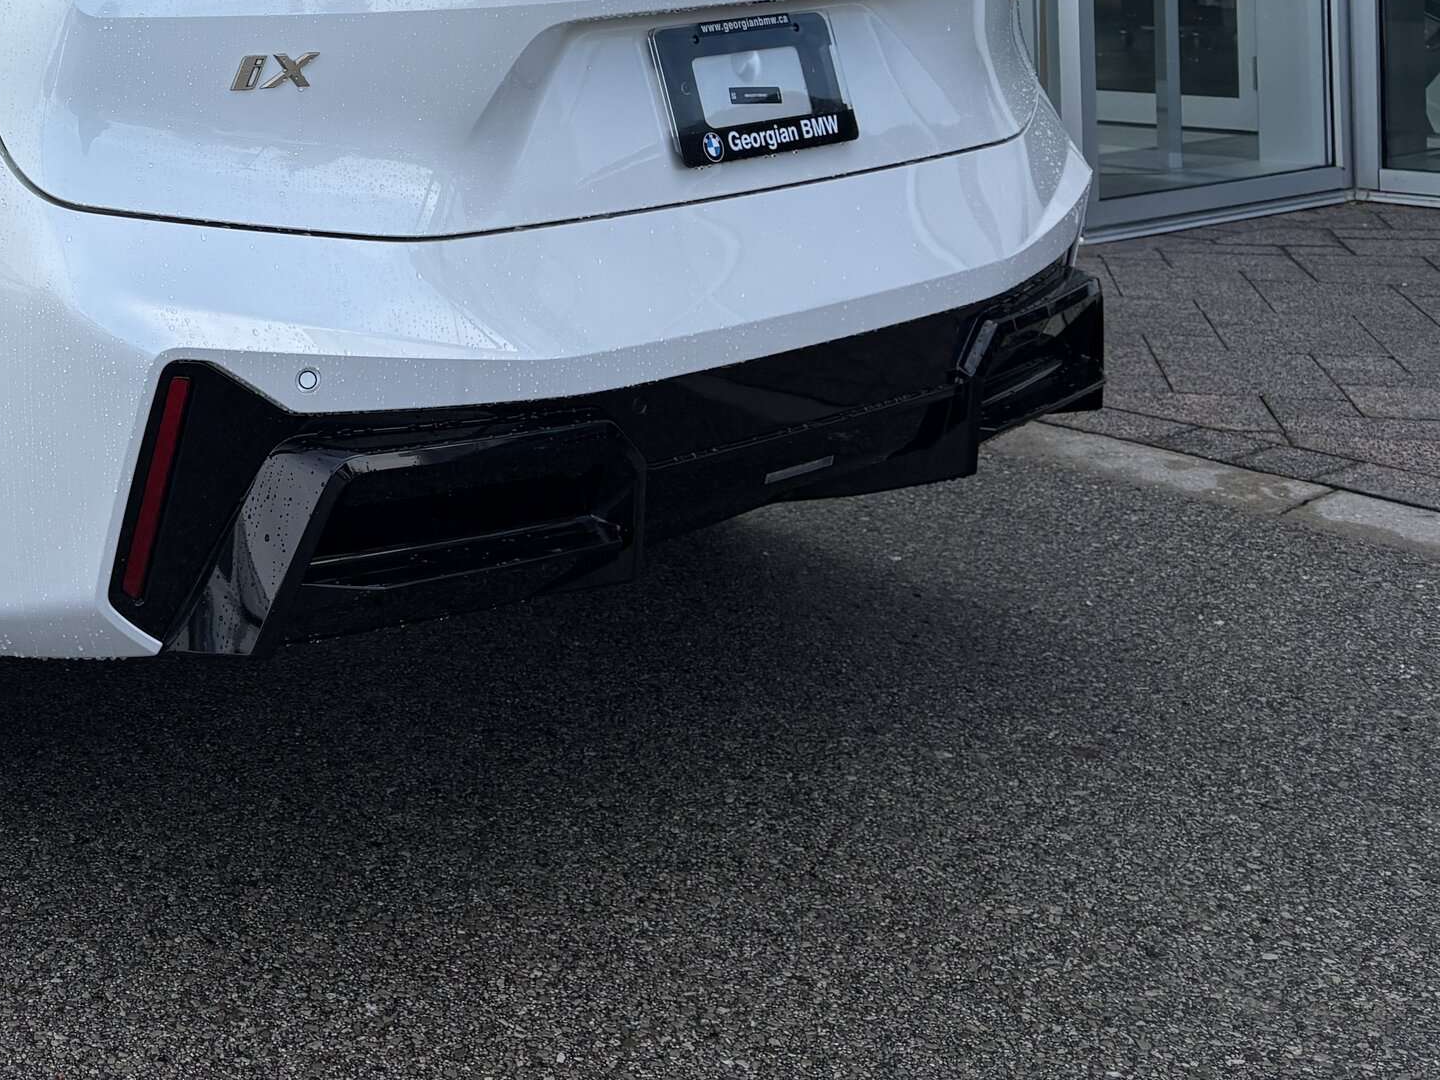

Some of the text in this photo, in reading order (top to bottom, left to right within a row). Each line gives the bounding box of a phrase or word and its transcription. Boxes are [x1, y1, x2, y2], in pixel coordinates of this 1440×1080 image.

[700, 15, 789, 33] www.georgianbmw.ca
[728, 124, 799, 151] Georgian
[800, 114, 839, 139] BMW
